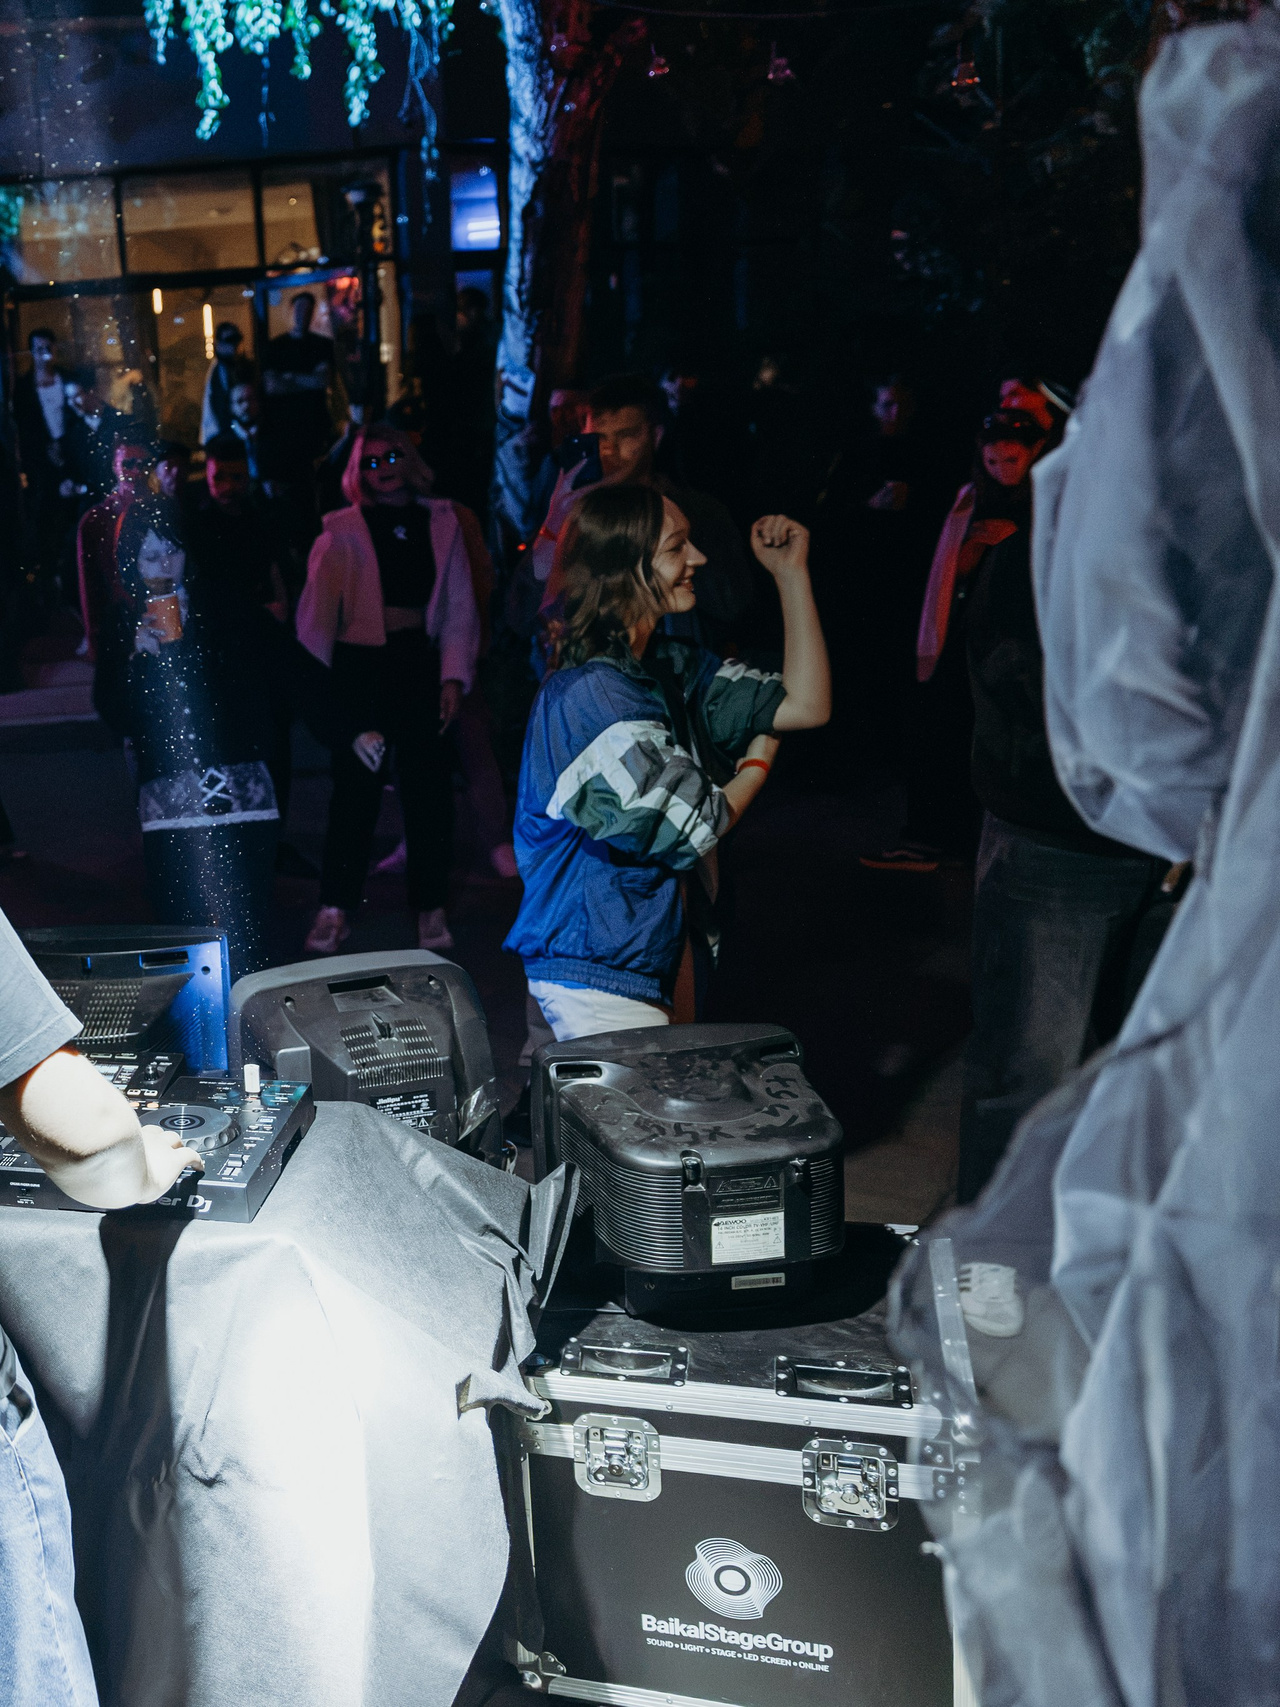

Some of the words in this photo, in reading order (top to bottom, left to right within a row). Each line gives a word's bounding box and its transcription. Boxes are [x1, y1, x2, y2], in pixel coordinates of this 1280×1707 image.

[641, 1613, 834, 1662] BaikalStageGroup
[646, 1637, 674, 1649] SOUND
[680, 1643, 704, 1654] LIGHT
[711, 1647, 737, 1659] STAGE
[743, 1653, 759, 1662] LED
[760, 1655, 792, 1667] SCREEN
[798, 1661, 830, 1673] ONLINE
